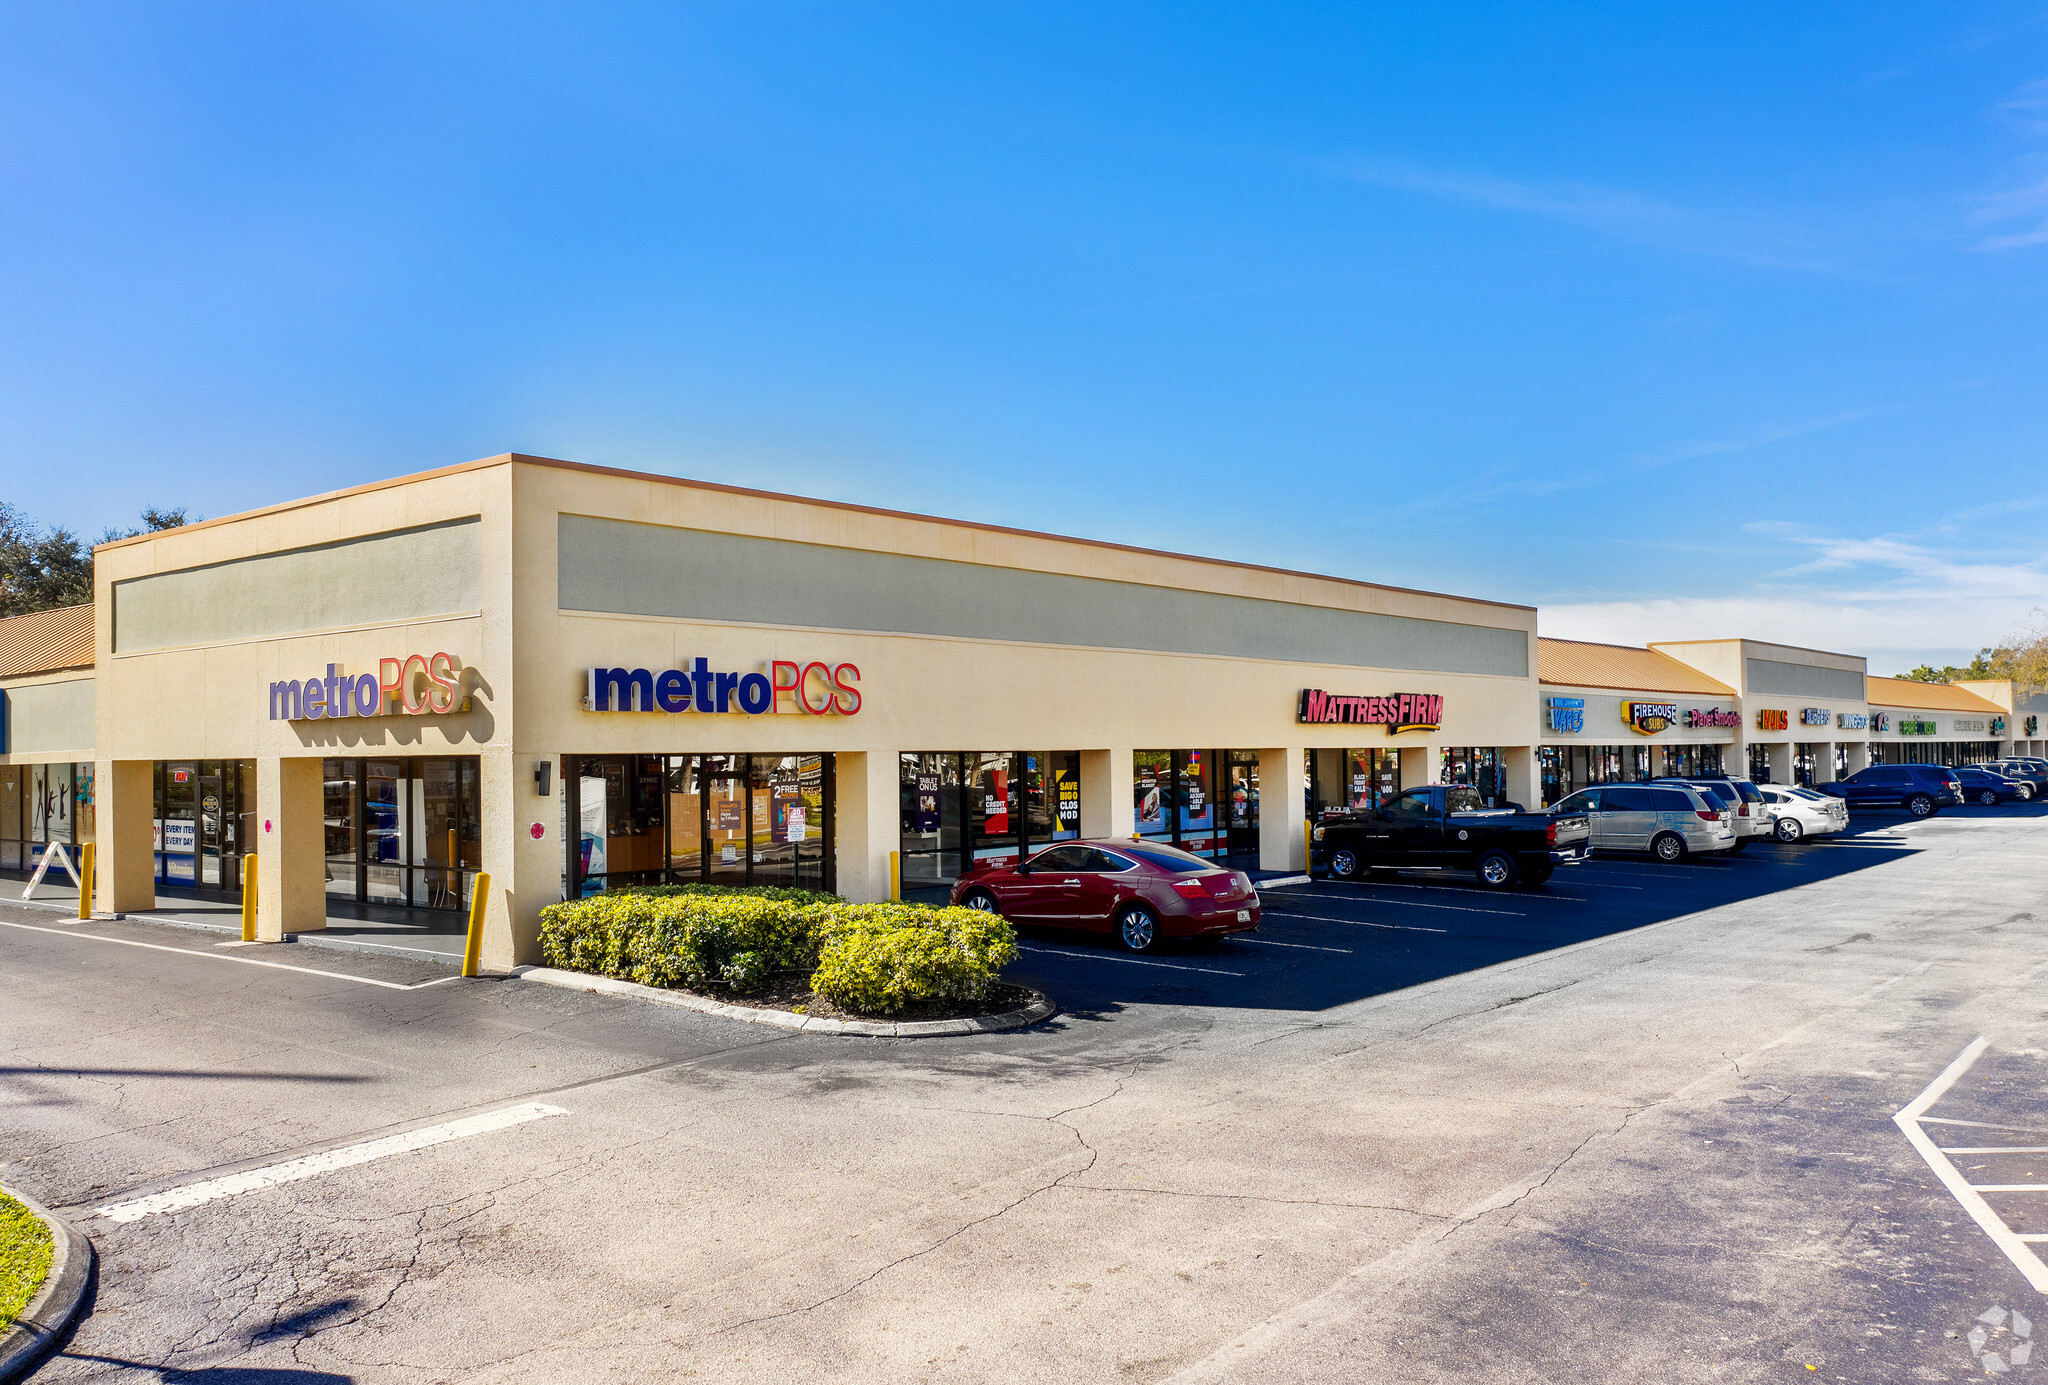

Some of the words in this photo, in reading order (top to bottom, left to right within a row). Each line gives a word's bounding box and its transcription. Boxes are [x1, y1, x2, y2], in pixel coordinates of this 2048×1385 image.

[270, 652, 455, 720] metroPCS
[593, 657, 863, 716] metroPCS
[1398, 694, 1444, 723] FIRM
[1634, 704, 1677, 724] FIREHOUSE
[1648, 719, 1665, 730] SUBS
[1692, 708, 1714, 728] Planet
[1761, 709, 1788, 730] NAILS
[1381, 773, 1392, 781] SAVE
[774, 785, 781, 798] 2
[781, 785, 799, 793] FREE
[1059, 781, 1078, 791] SAVE
[1354, 785, 1366, 793] SALE
[985, 807, 1007, 815] NEEDED
[166, 825, 182, 833] EVERY
[166, 836, 182, 845] EVERY
[183, 837, 193, 846] DAY
[168, 862, 194, 875] Vitamins
